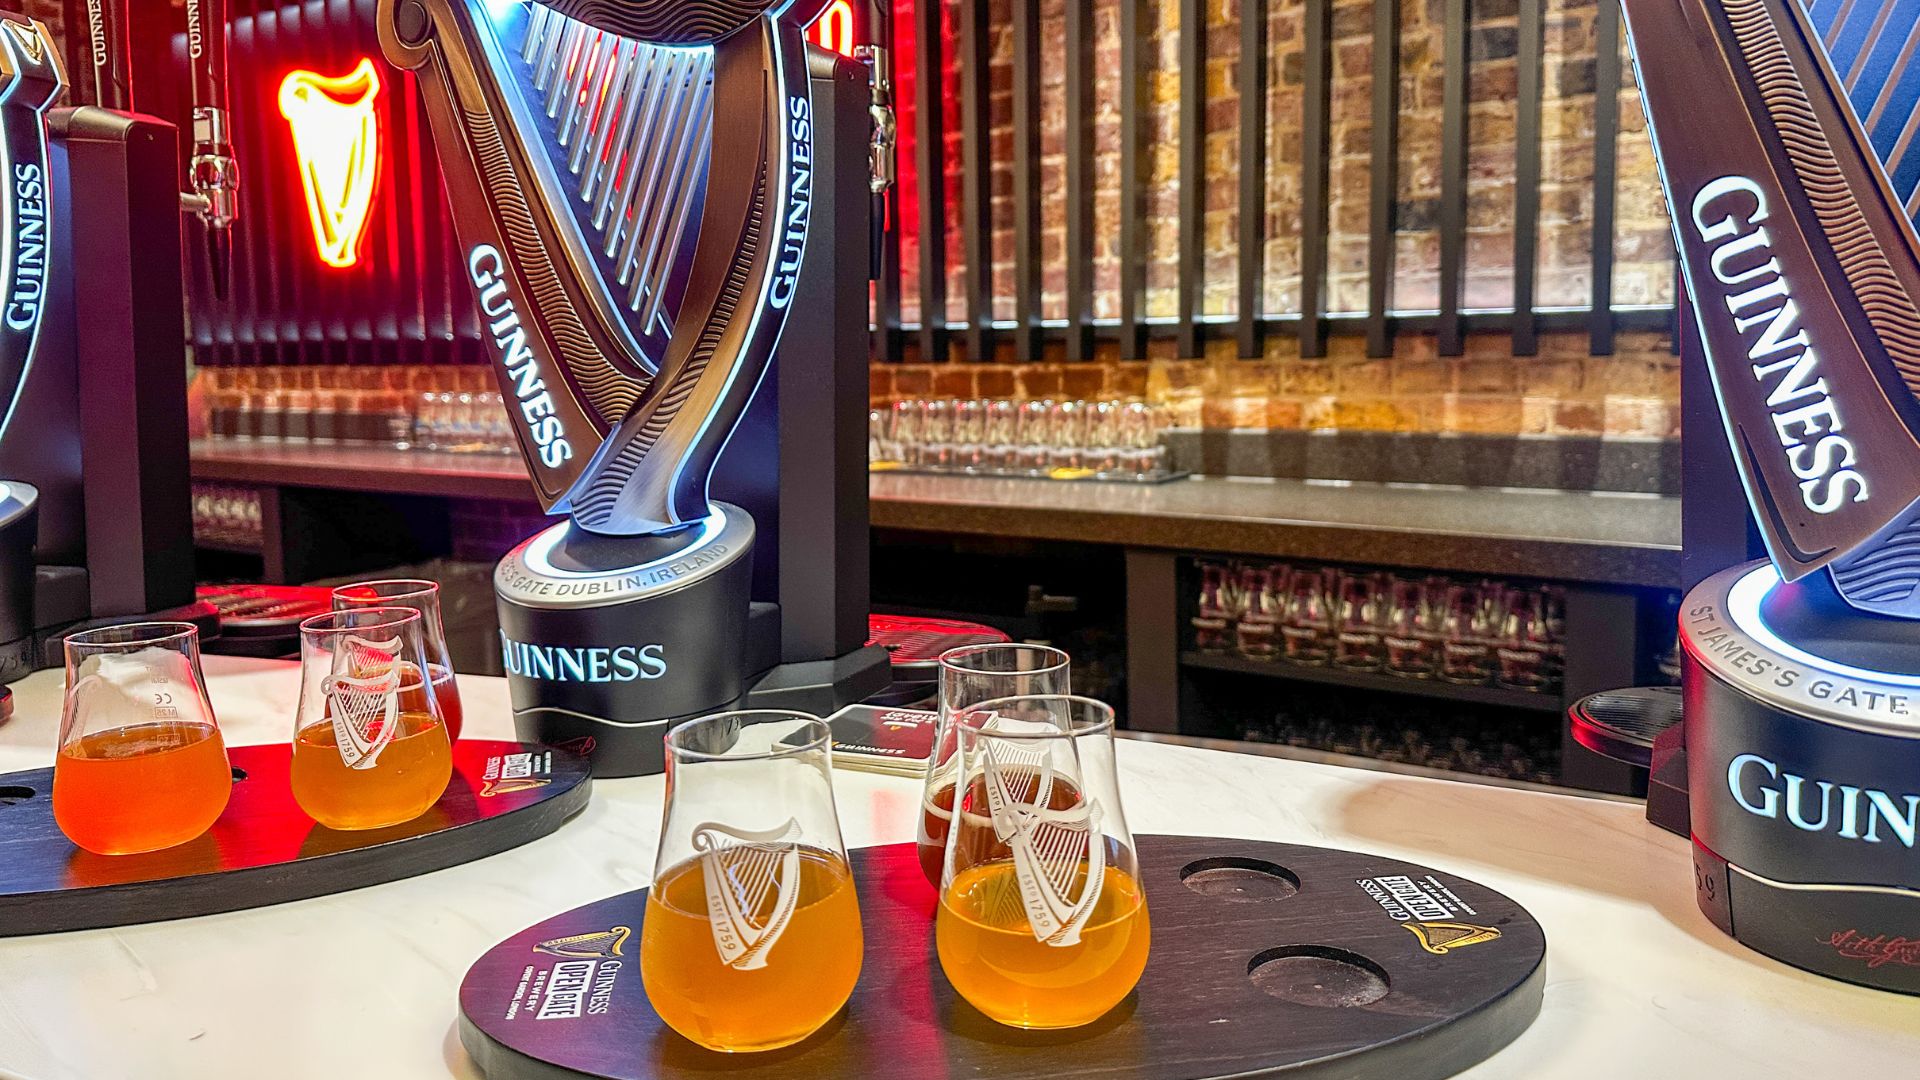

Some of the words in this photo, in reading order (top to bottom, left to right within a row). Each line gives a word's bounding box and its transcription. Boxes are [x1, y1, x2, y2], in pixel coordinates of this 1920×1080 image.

[770, 96, 811, 309] GUINNESS
[6, 164, 44, 331] GUINNESS
[468, 243, 573, 468] GUINNESS
[1691, 175, 1869, 514] GUINNESS
[512, 576, 553, 595] GATE
[649, 544, 729, 583] IRELAND
[1690, 605, 1715, 624] ST
[1698, 627, 1800, 687] JAMES'S
[1808, 680, 1909, 715] GATE
[1727, 753, 1920, 849] GUIN
[1029, 899, 1050, 927] 1759
[1355, 879, 1411, 920] GUINNESS
[1400, 894, 1446, 917] OPEN
[716, 921, 736, 950] 1759
[524, 970, 549, 1011] BREWERY
[552, 963, 590, 992] OPEN
[587, 960, 622, 1014] GUINNESS
[544, 993, 577, 1017] GATE
